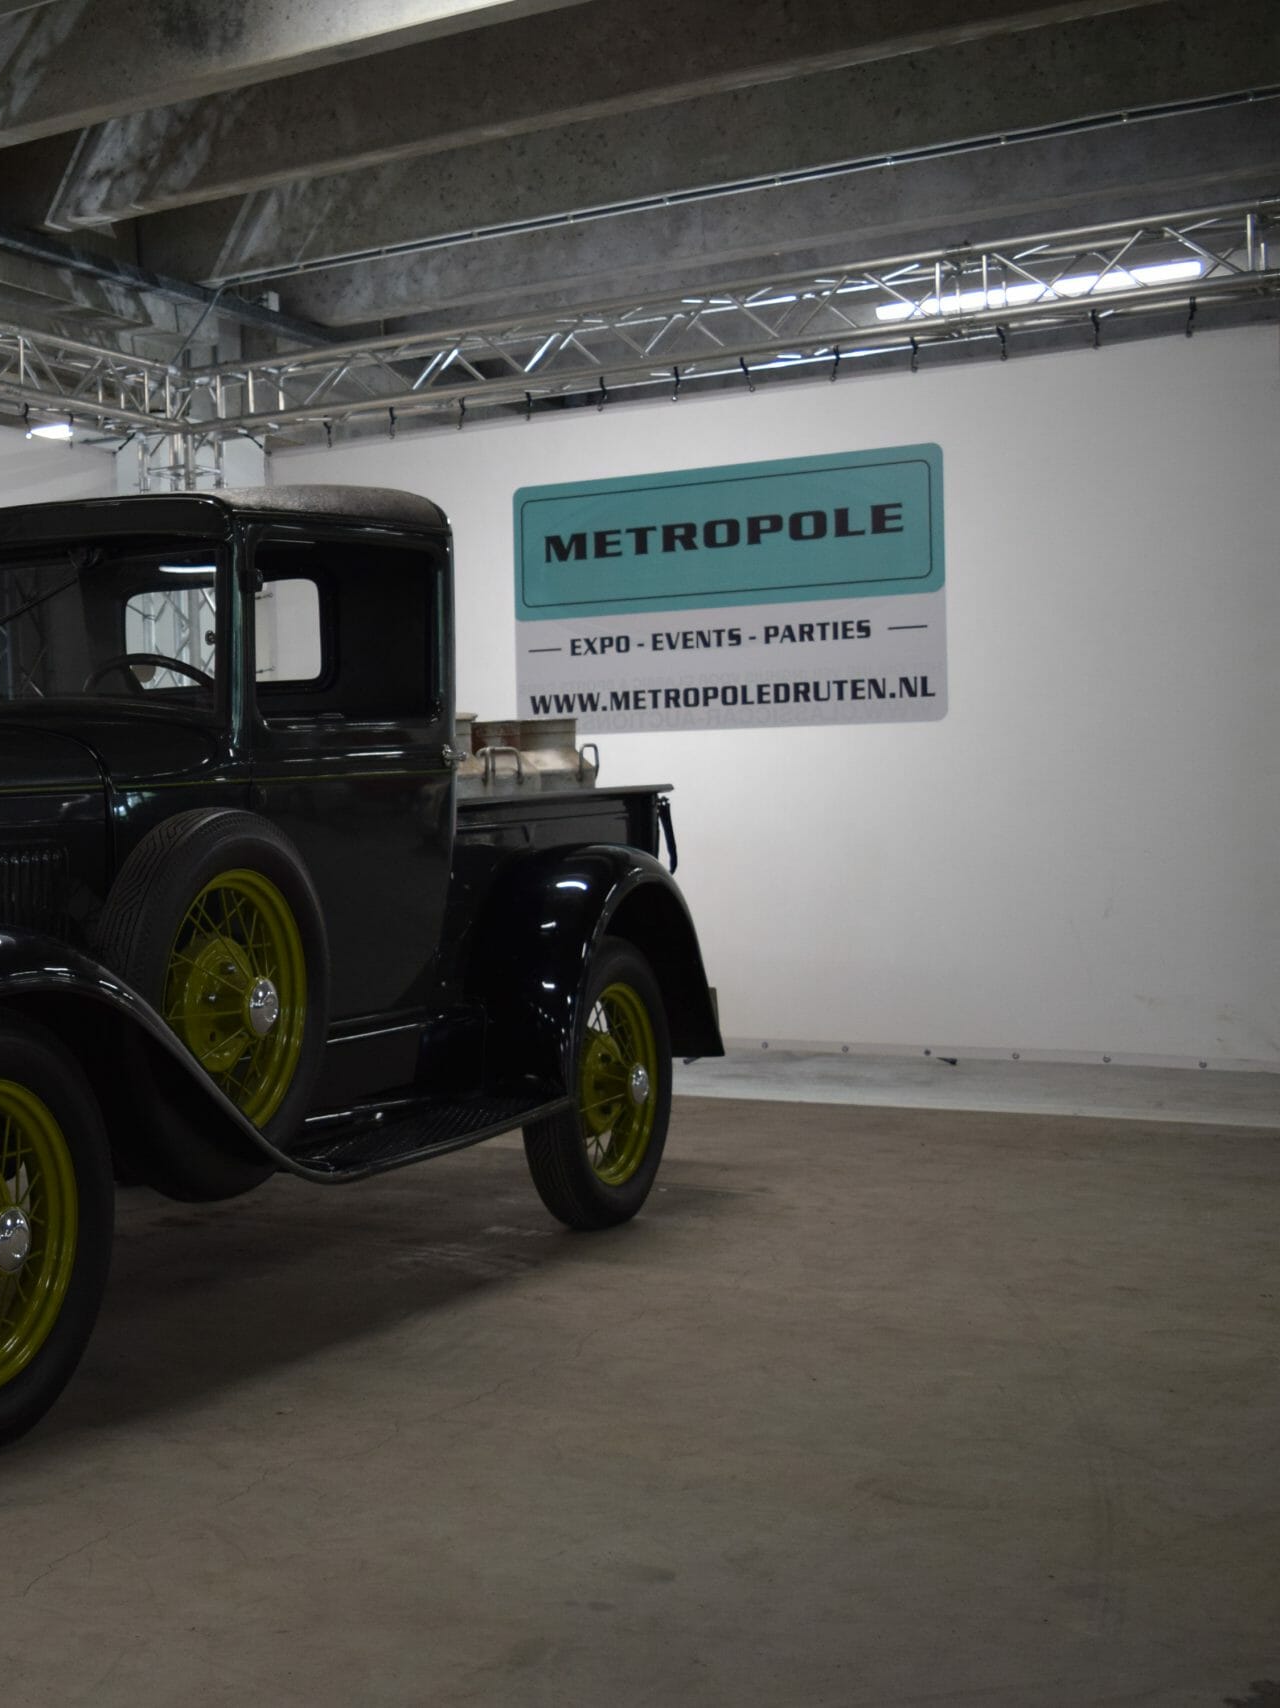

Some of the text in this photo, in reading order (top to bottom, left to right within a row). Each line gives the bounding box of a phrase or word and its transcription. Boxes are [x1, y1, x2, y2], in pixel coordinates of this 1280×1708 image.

[544, 503, 904, 563] METROPOLE
[569, 635, 631, 656] EXPO
[651, 628, 742, 652] EVENTS
[764, 620, 871, 644] PARTIES
[530, 675, 936, 715] WWW.METROPOLEDRUTEN.NL
